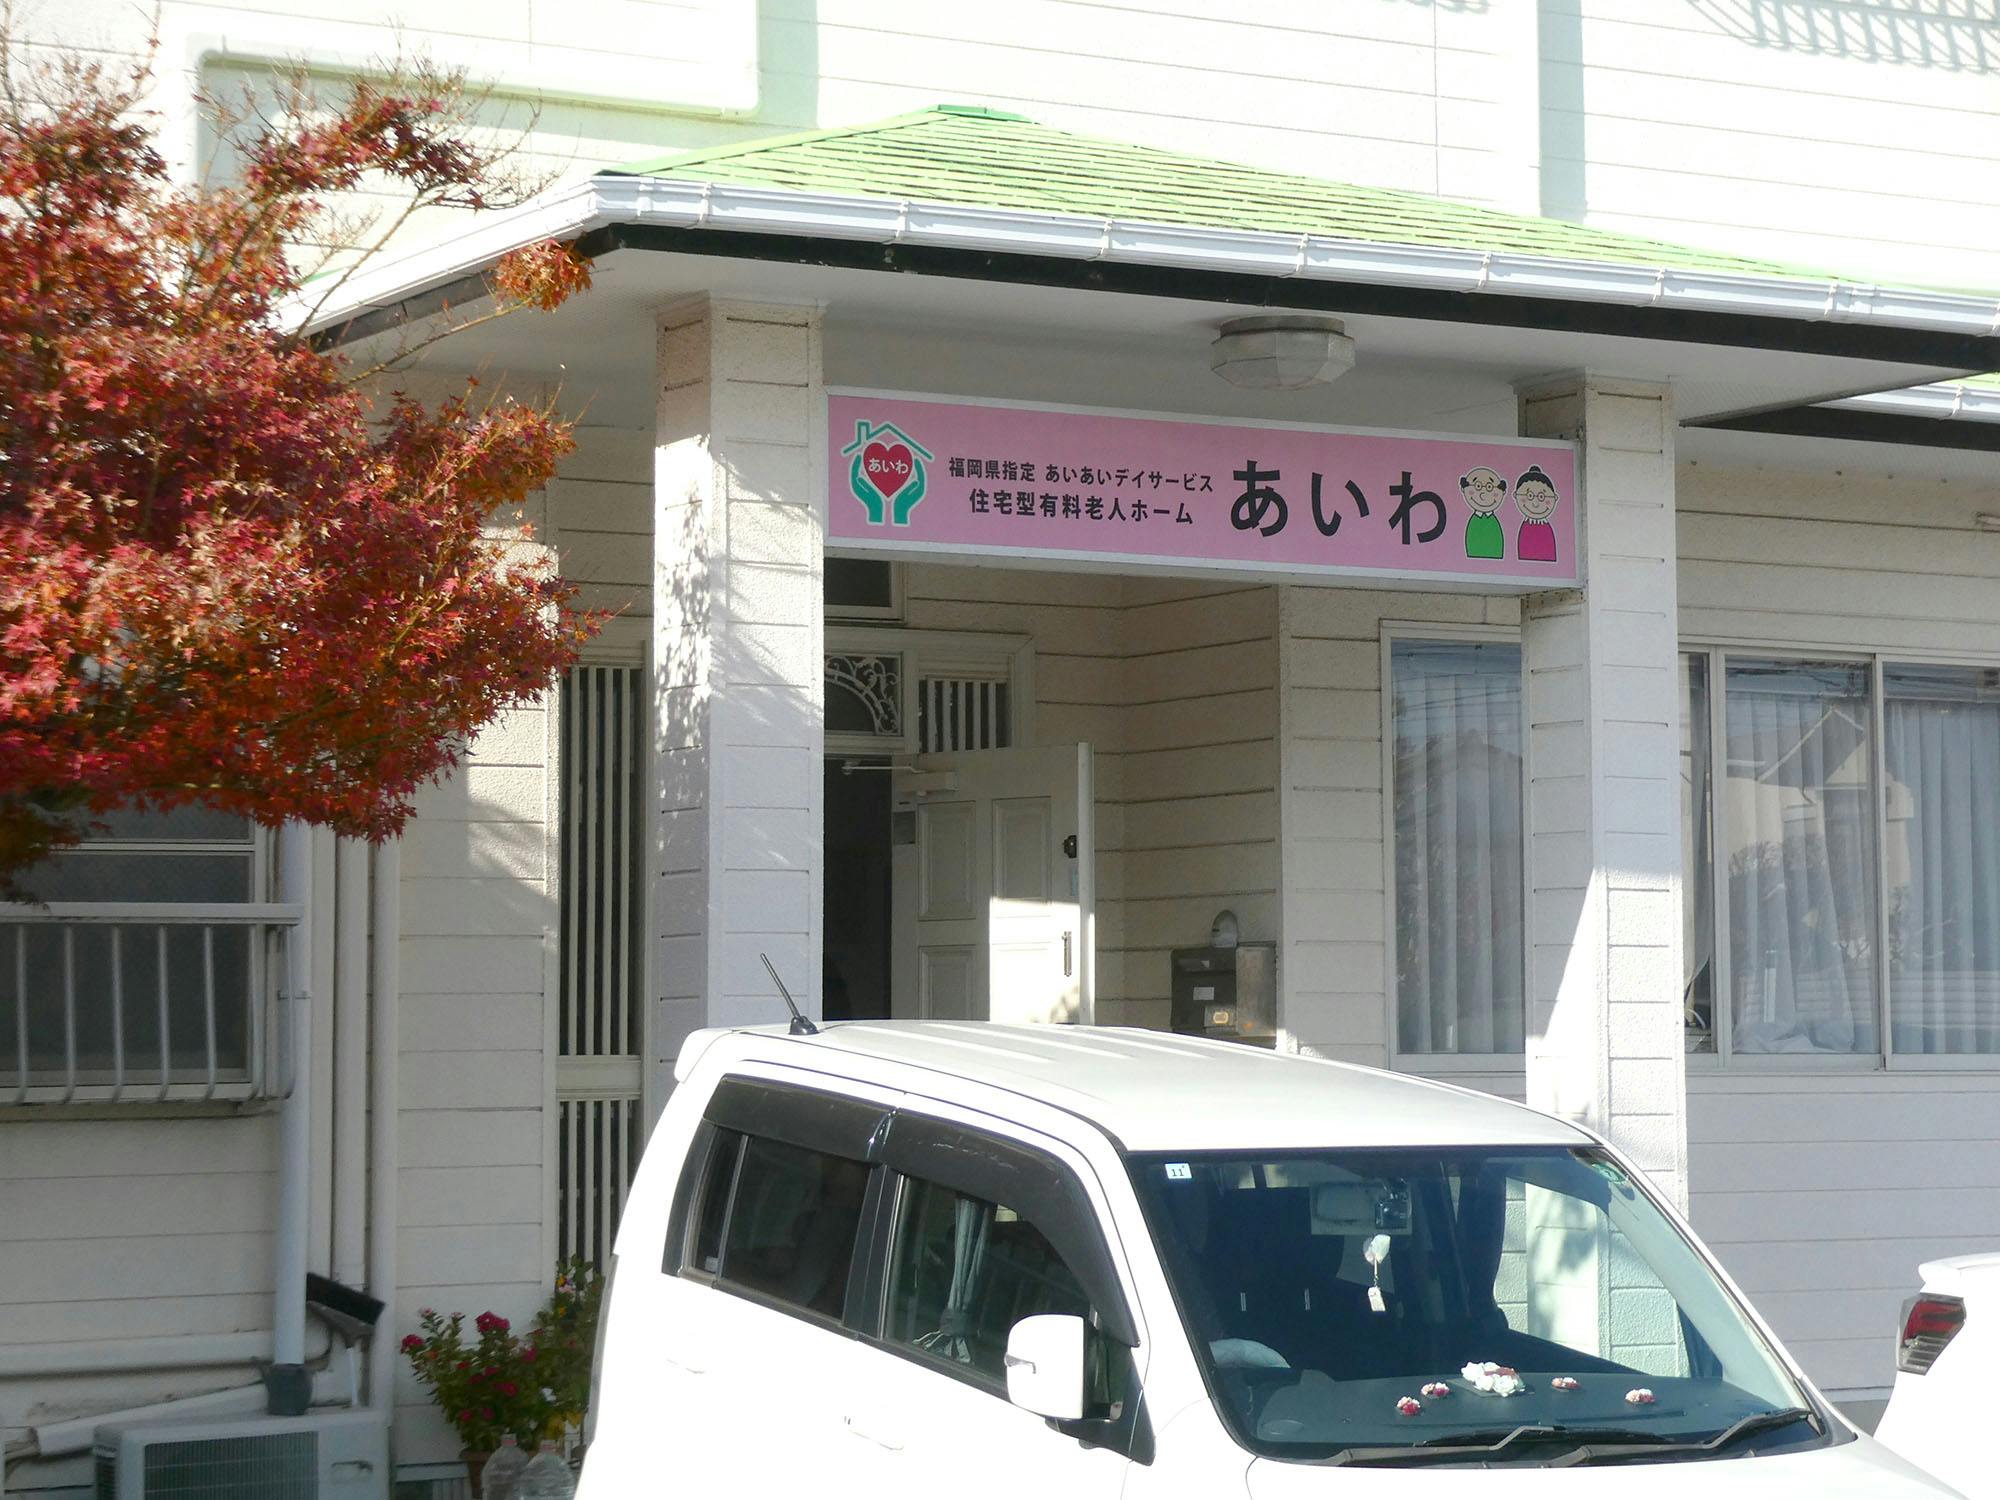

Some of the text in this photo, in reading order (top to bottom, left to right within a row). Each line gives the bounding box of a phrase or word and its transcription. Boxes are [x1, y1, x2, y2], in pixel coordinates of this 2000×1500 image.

[868, 457, 909, 475] あいわ
[949, 457, 1213, 492] 福岡県指定 あいあいデイサービス
[969, 488, 1193, 524] 住宅型有料老人ホーム
[1230, 460, 1447, 545] あいわ
